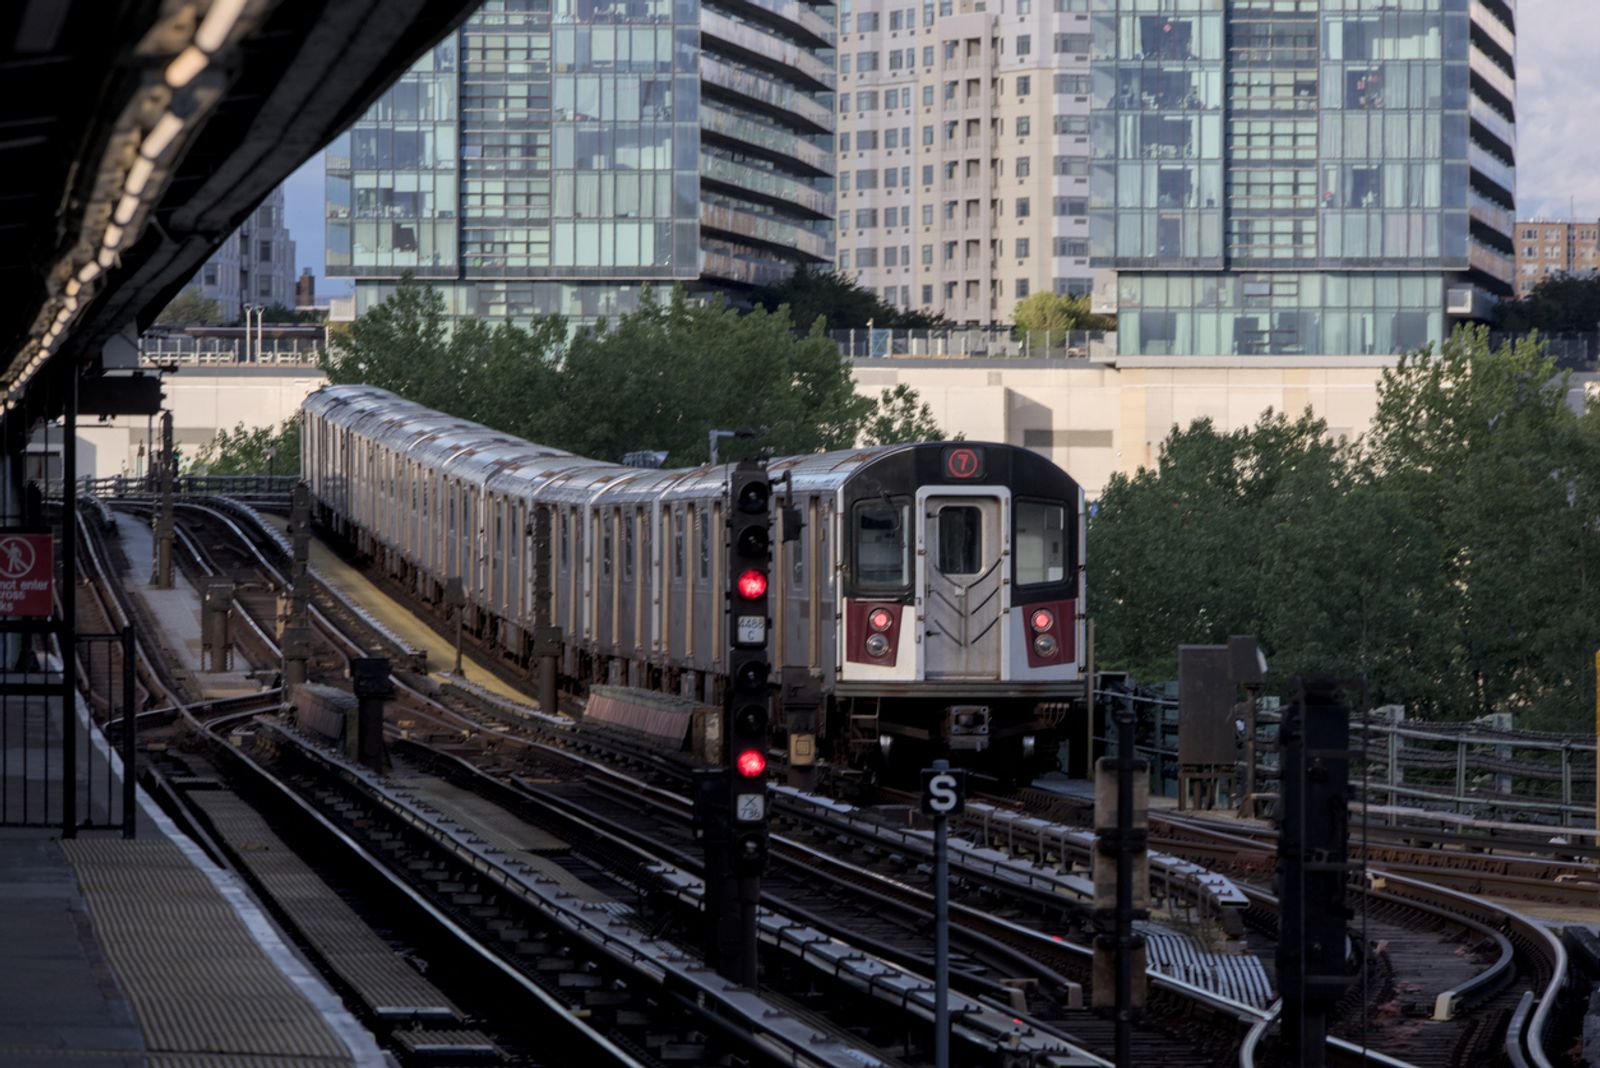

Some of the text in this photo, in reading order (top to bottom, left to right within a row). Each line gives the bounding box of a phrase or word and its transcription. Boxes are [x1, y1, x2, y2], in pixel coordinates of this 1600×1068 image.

[958, 454, 969, 471] 7
[20, 580, 49, 591] enter
[747, 630, 755, 641] C
[929, 775, 957, 811] S
